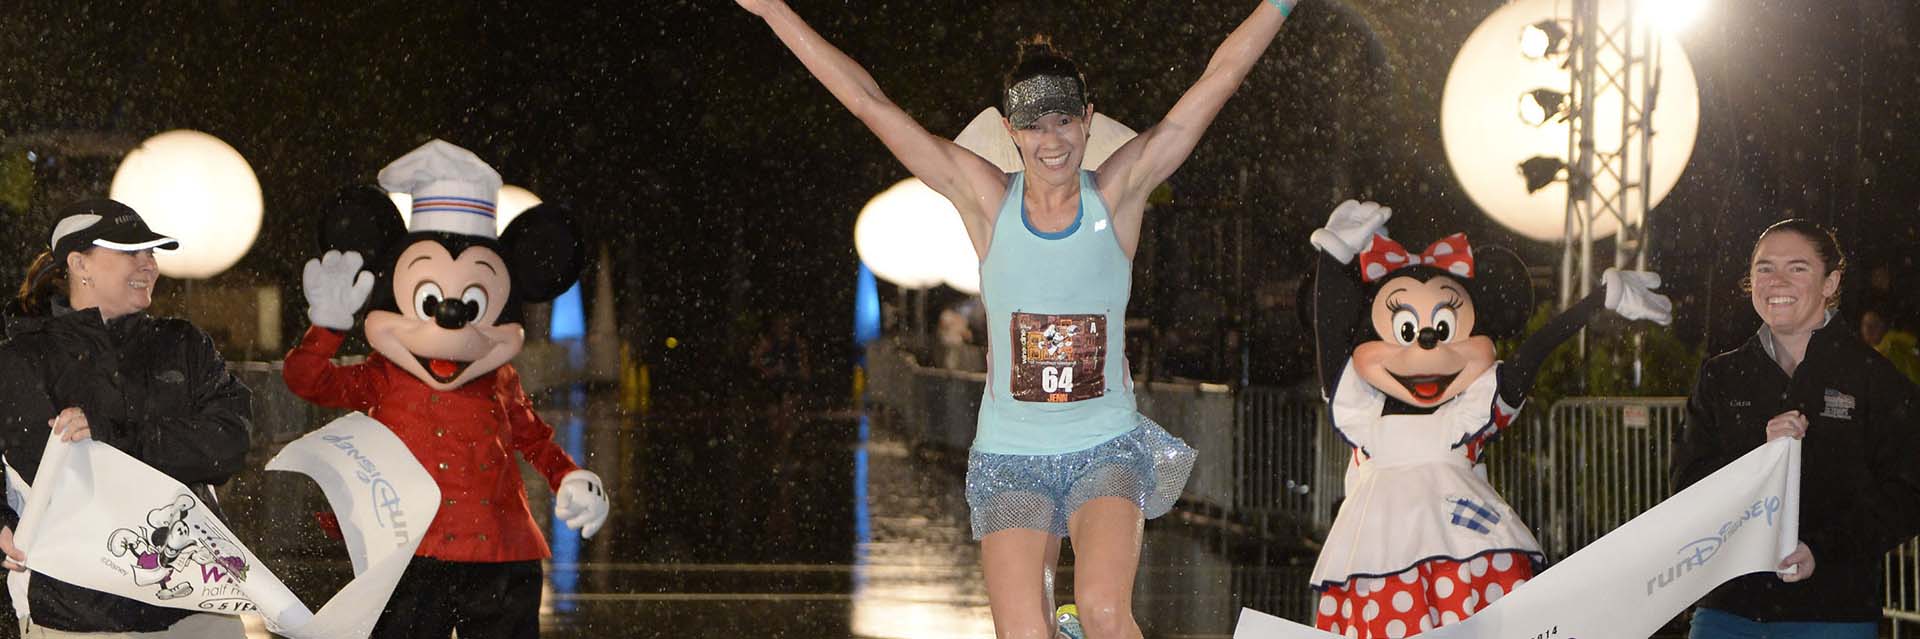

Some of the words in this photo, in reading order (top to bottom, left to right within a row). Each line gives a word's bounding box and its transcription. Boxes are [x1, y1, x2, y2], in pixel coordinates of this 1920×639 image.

[1090, 322, 1097, 334] A
[1042, 366, 1074, 393] 64
[217, 602, 229, 610] 5
[233, 602, 258, 611] YEA
[1531, 625, 1558, 639] 014
